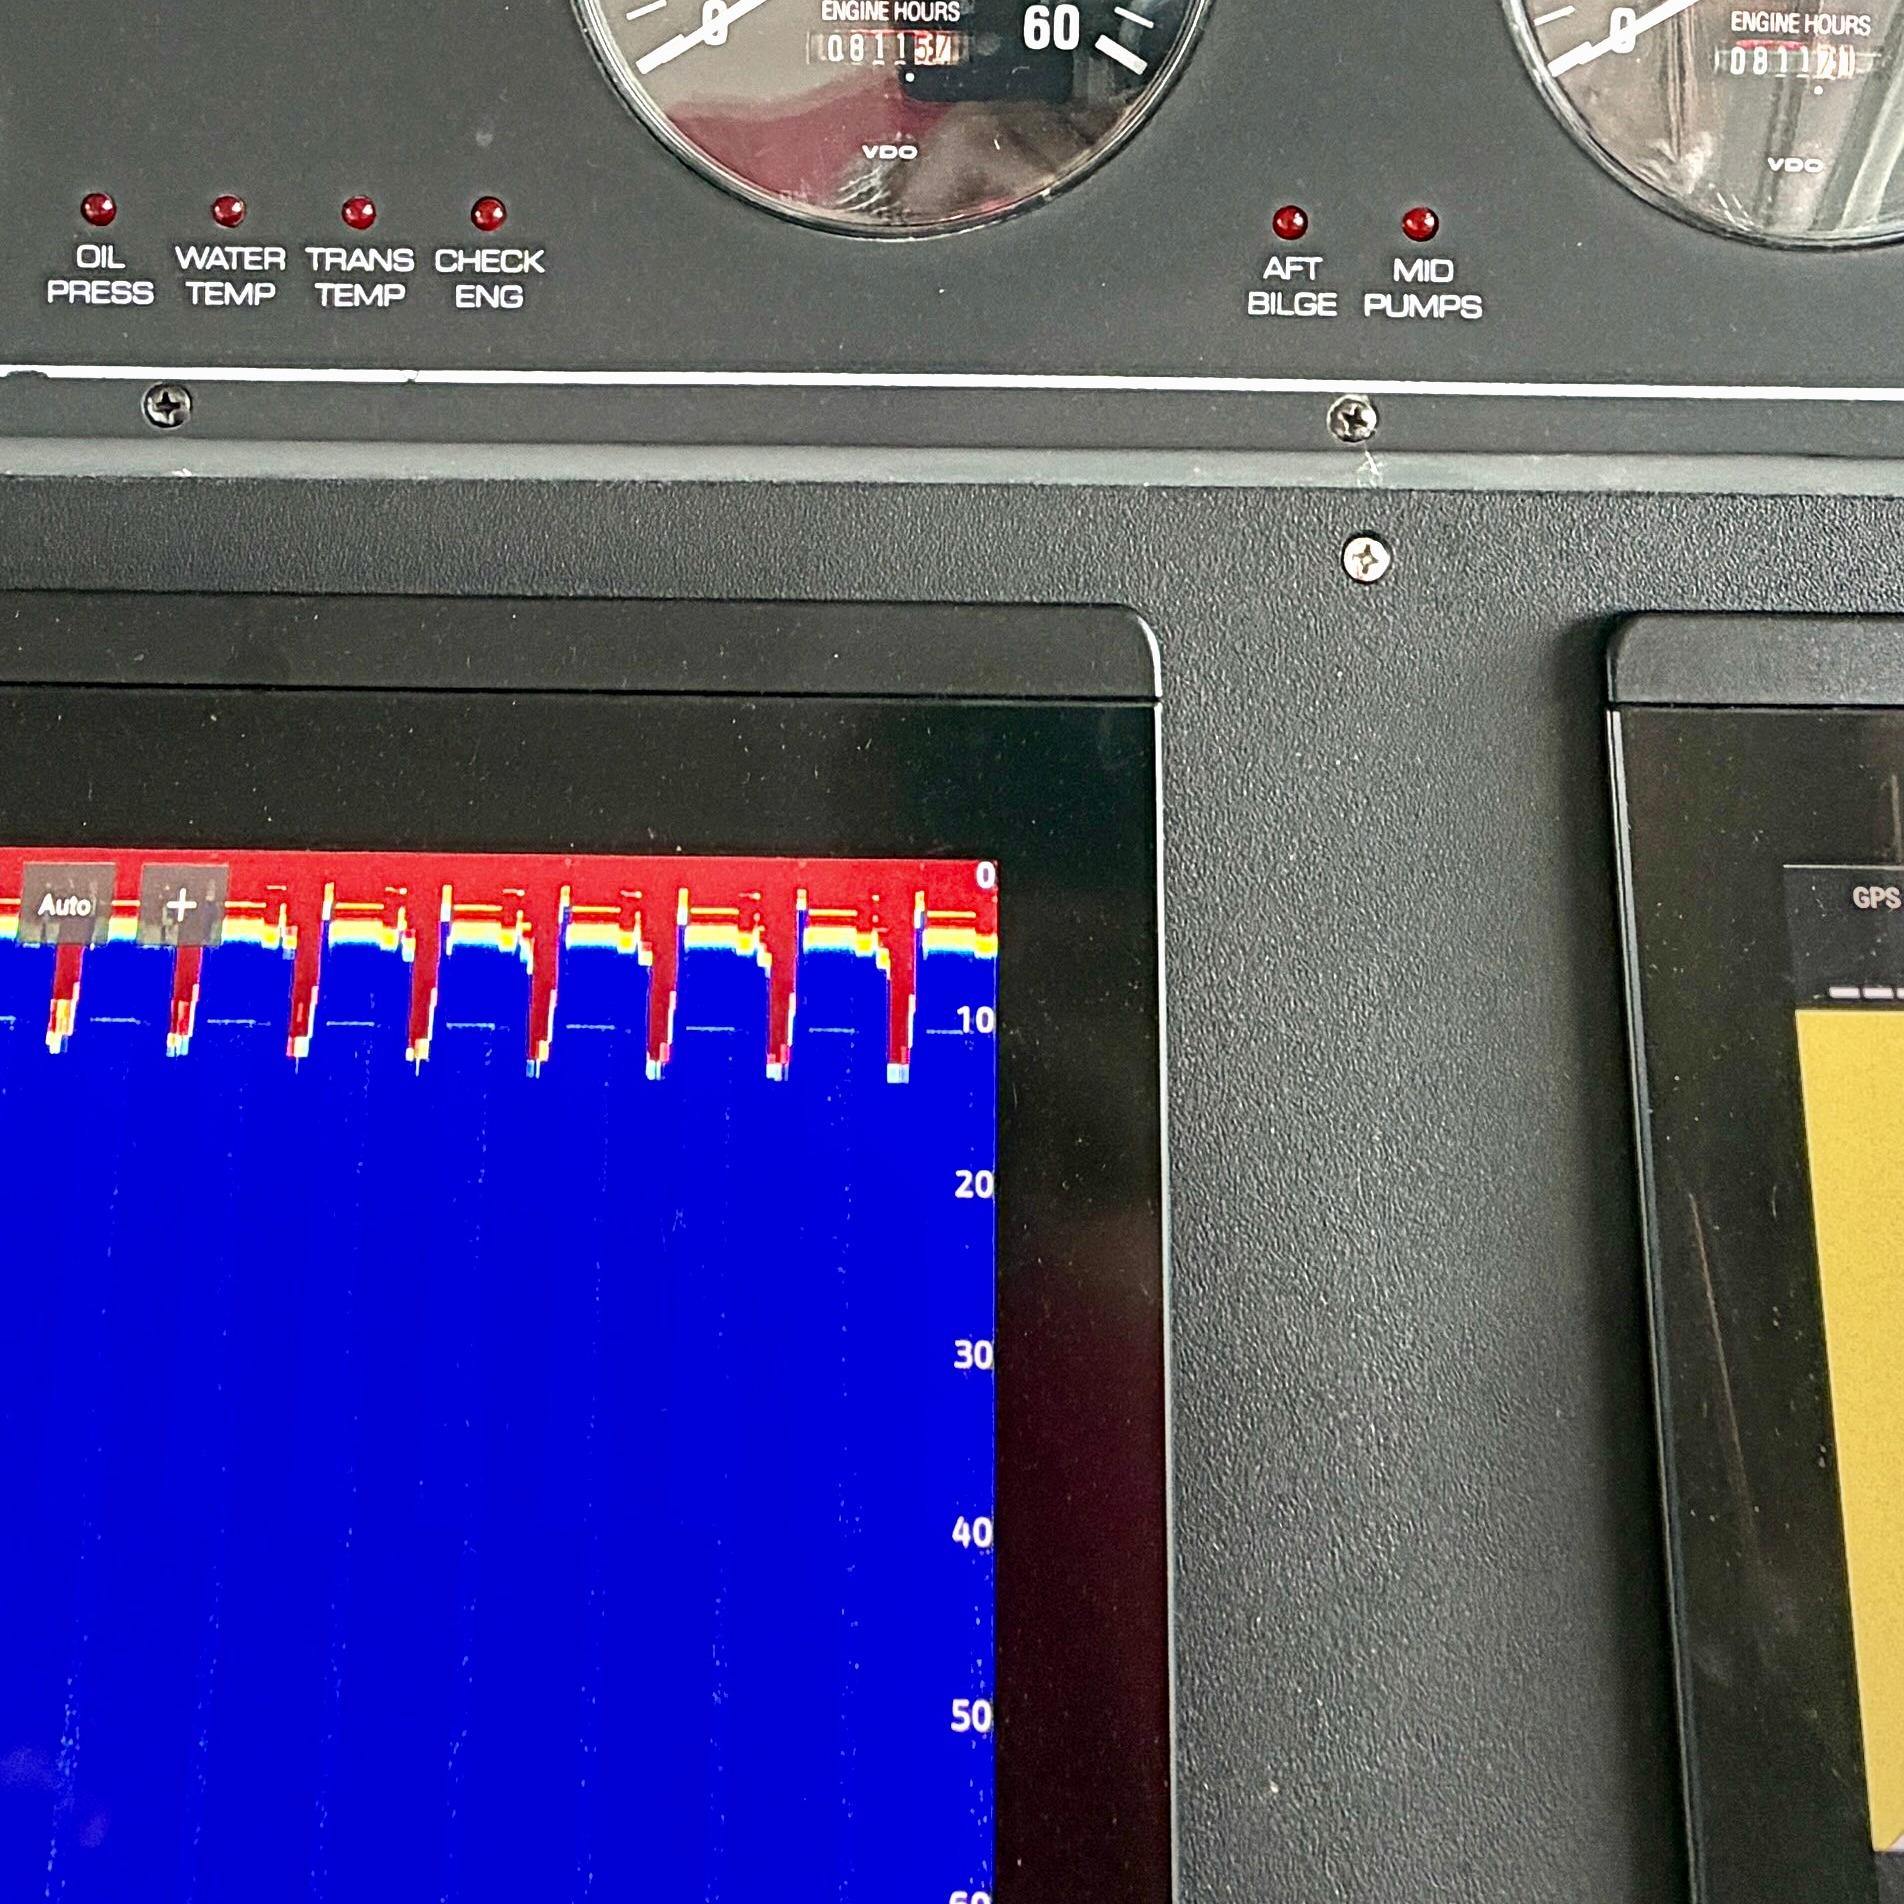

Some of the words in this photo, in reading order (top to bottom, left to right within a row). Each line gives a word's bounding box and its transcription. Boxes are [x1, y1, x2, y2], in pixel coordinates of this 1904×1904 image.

[701, 0, 728, 45] 0
[821, 0, 890, 21] ENGINE
[894, 1, 961, 22] HOURS
[1731, 11, 1800, 33] ENGINE
[1804, 13, 1871, 36] HOURS
[1023, 4, 1079, 50] 60
[1610, 7, 1637, 53] 0
[862, 145, 918, 159] VDO
[1768, 158, 1824, 172] VDO
[76, 244, 125, 270] OIL
[175, 245, 286, 272] WATER
[305, 247, 415, 273] TRANS
[435, 248, 545, 274] CHECK
[1262, 256, 1324, 281] AFT
[1393, 258, 1454, 283] MID
[47, 280, 155, 306] PRESS
[186, 281, 276, 307] TEMP
[314, 282, 406, 308] TEMP
[455, 284, 524, 309] ENG
[1247, 291, 1338, 317] BILGE
[1364, 293, 1483, 319] PUMPS
[976, 862, 996, 889] 0
[37, 893, 92, 917] Auto
[1853, 886, 1901, 910] GPS
[957, 1006, 995, 1035] 10
[955, 1169, 995, 1199] 20
[953, 1339, 995, 1369] 30
[951, 1516, 994, 1548] 40
[949, 1699, 993, 1732] 50
